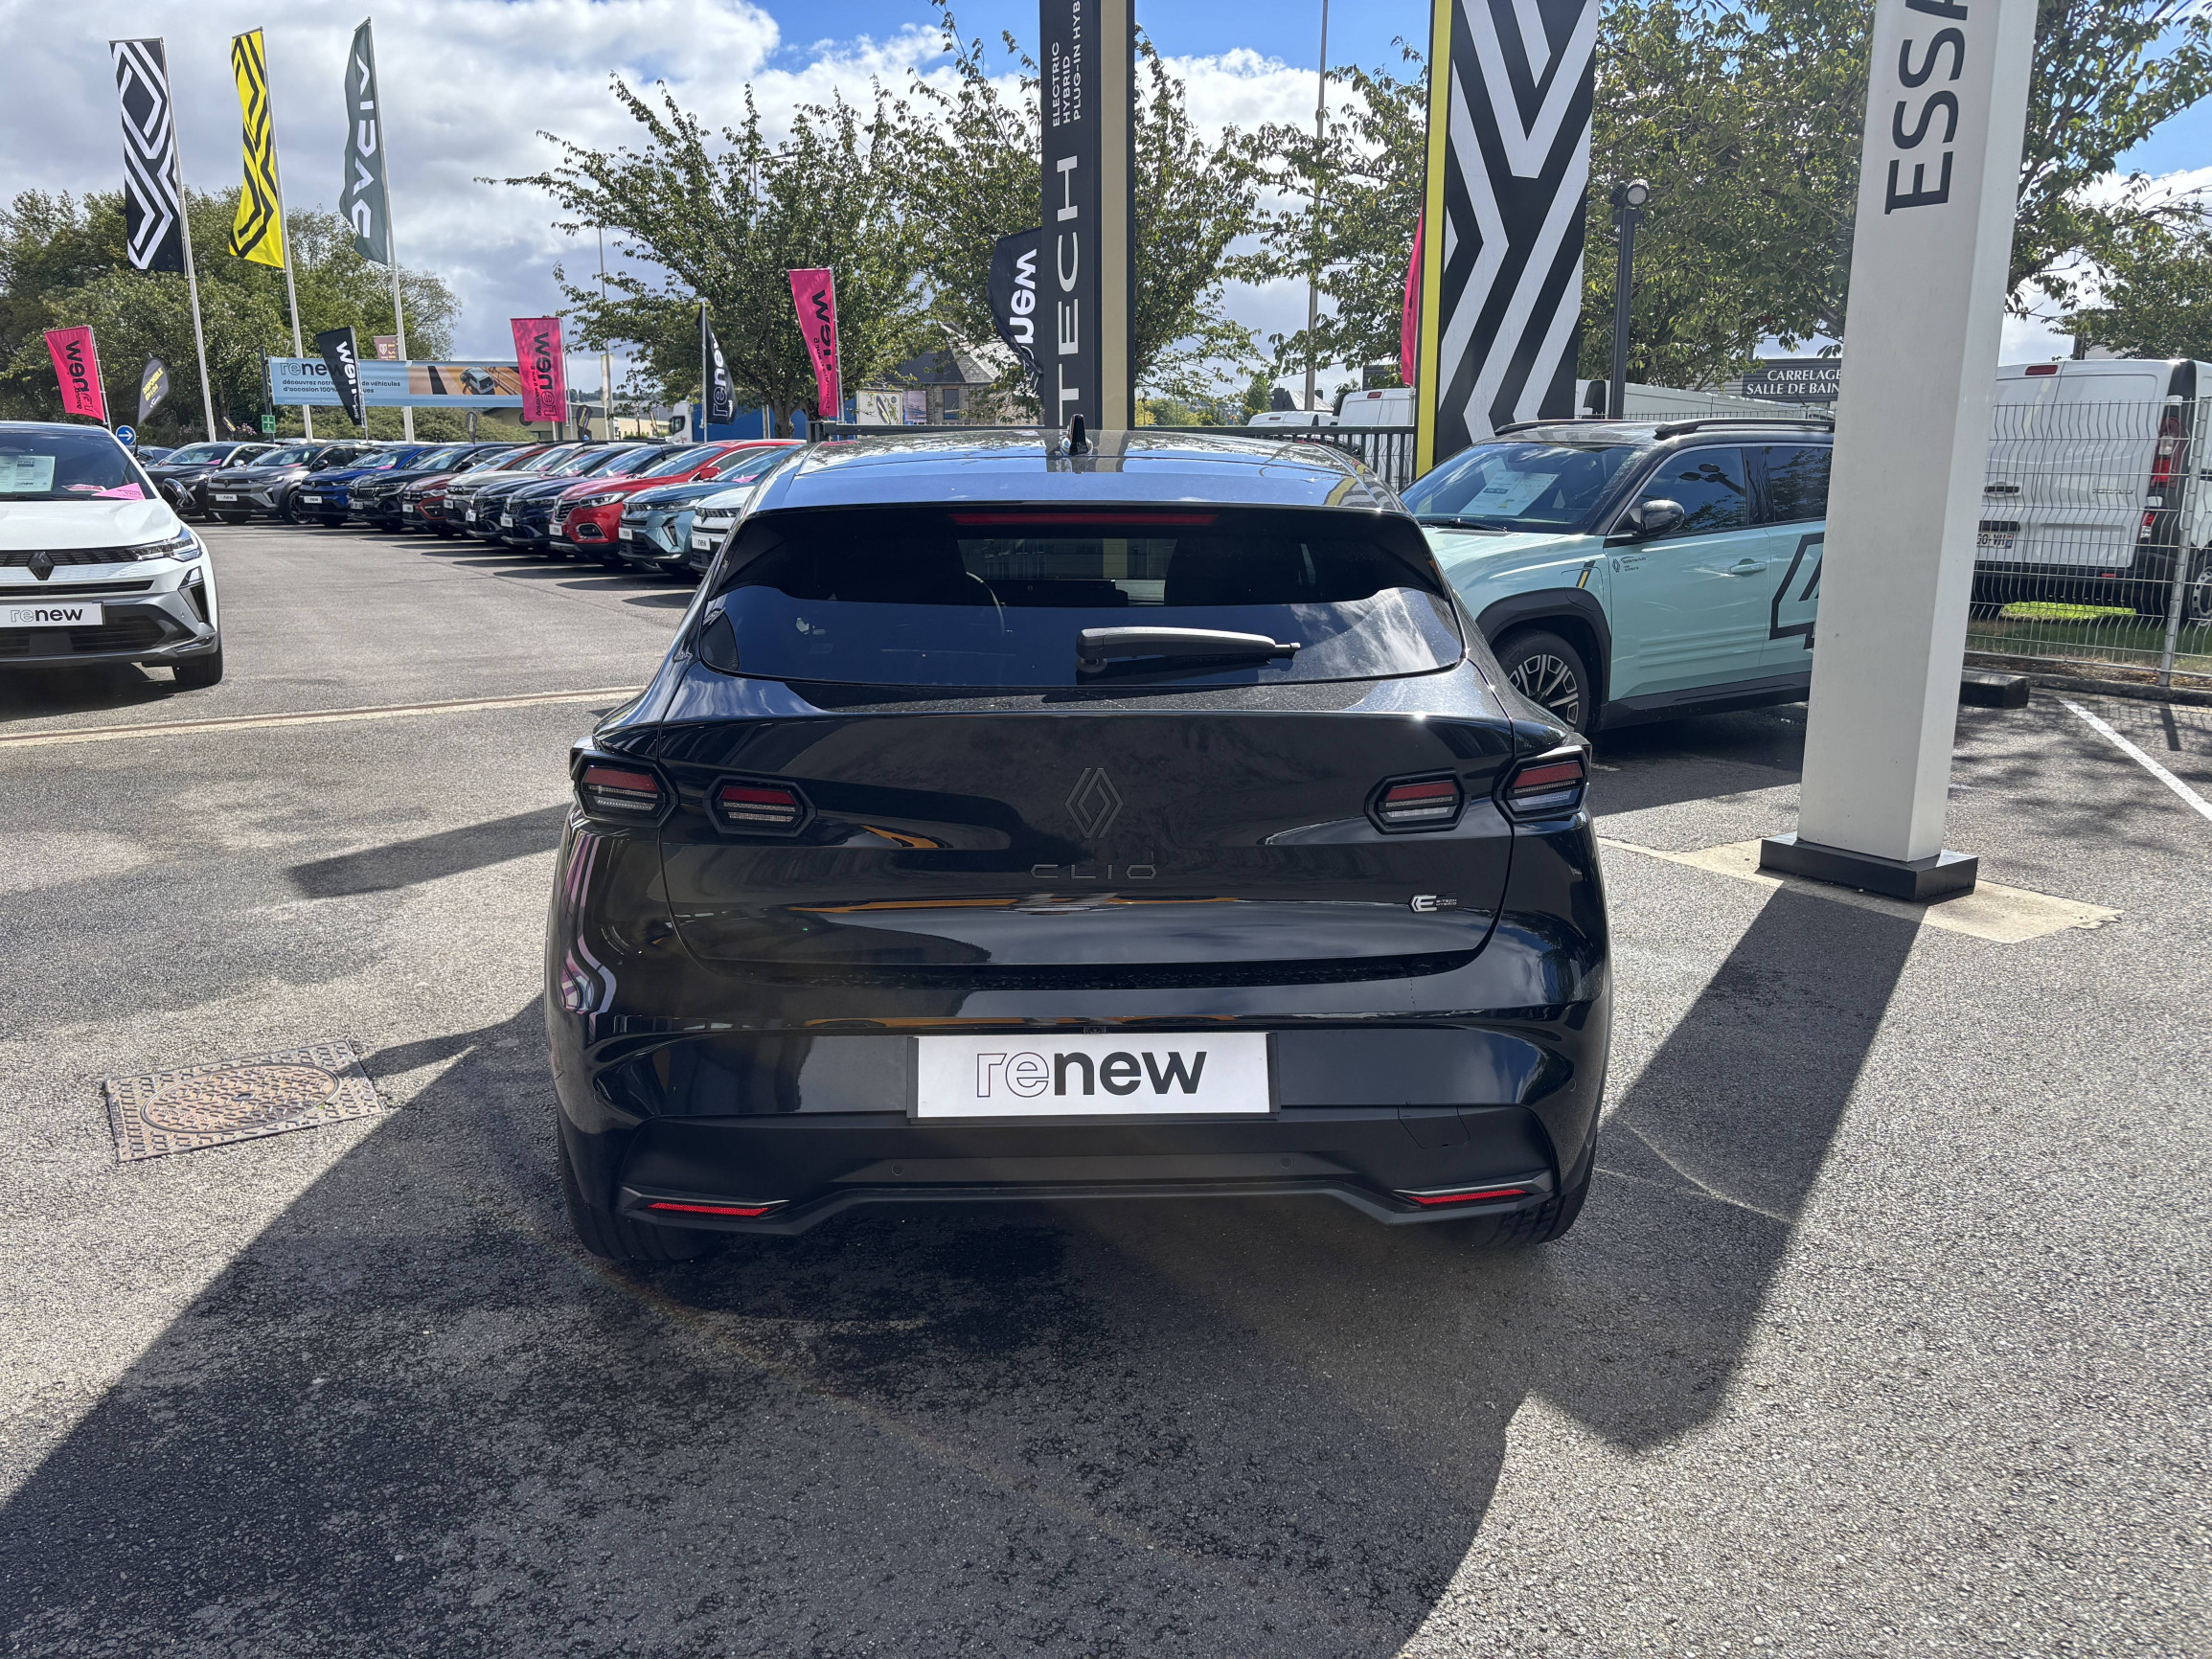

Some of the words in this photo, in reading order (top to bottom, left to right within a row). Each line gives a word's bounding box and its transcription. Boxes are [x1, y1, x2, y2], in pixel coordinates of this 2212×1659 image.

[1072, 0, 1082, 40] HYB
[1052, 41, 1060, 127] ELECTRIC
[1062, 55, 1071, 125] HYBRID
[1073, 43, 1082, 121] PLUG-IN
[1746, 383, 1785, 395] SALLE
[1788, 383, 1806, 395] DE
[11, 608, 83, 623] renew
[1030, 864, 1157, 880] CLIO
[976, 1051, 1208, 1099] renew
